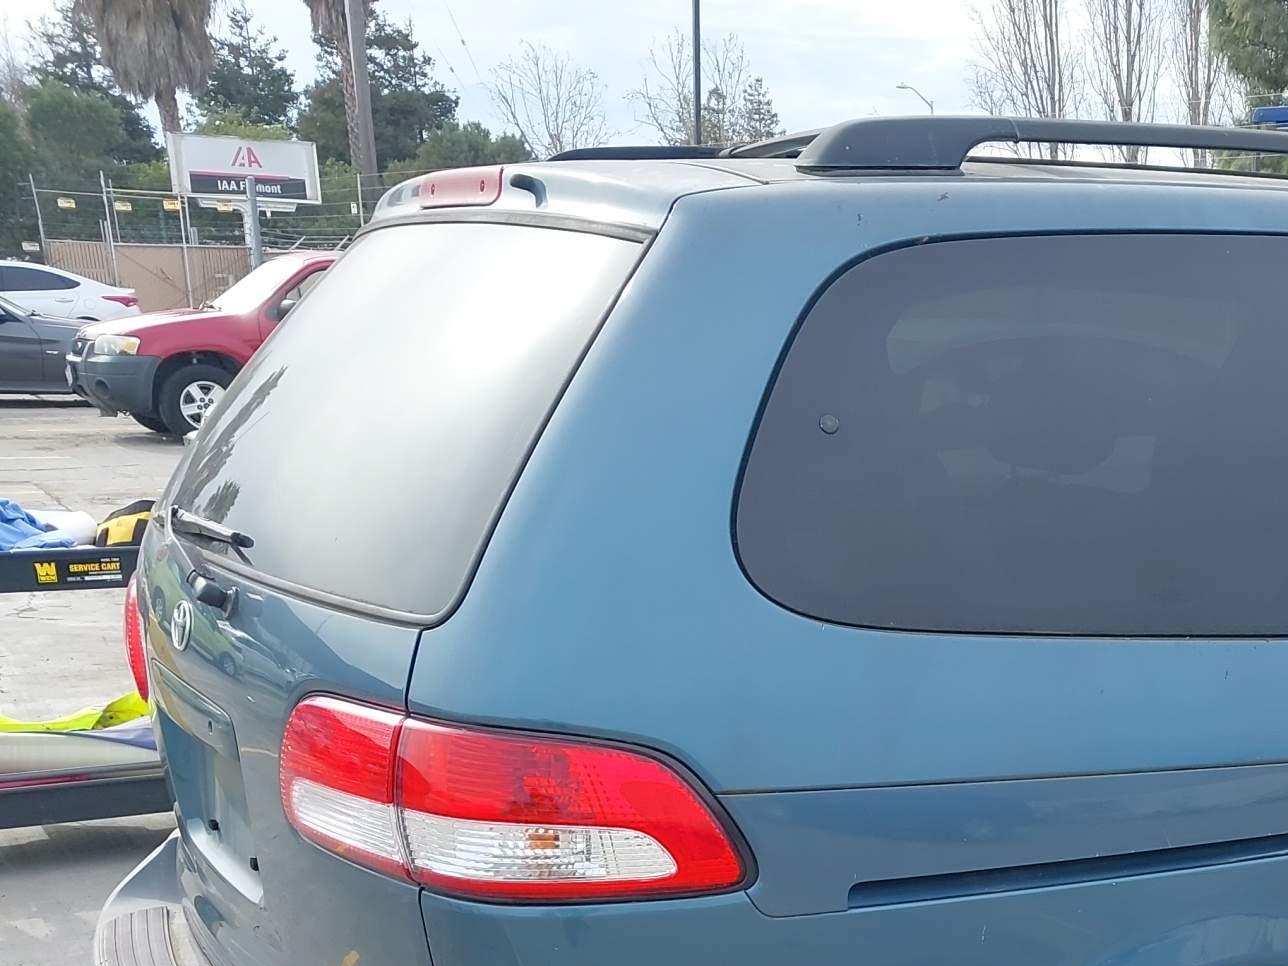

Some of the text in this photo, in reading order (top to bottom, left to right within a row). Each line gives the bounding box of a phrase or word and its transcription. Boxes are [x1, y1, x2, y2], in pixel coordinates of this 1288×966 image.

[217, 179, 282, 194] IAA Fmont
[68, 562, 121, 572] SERVICE CART
